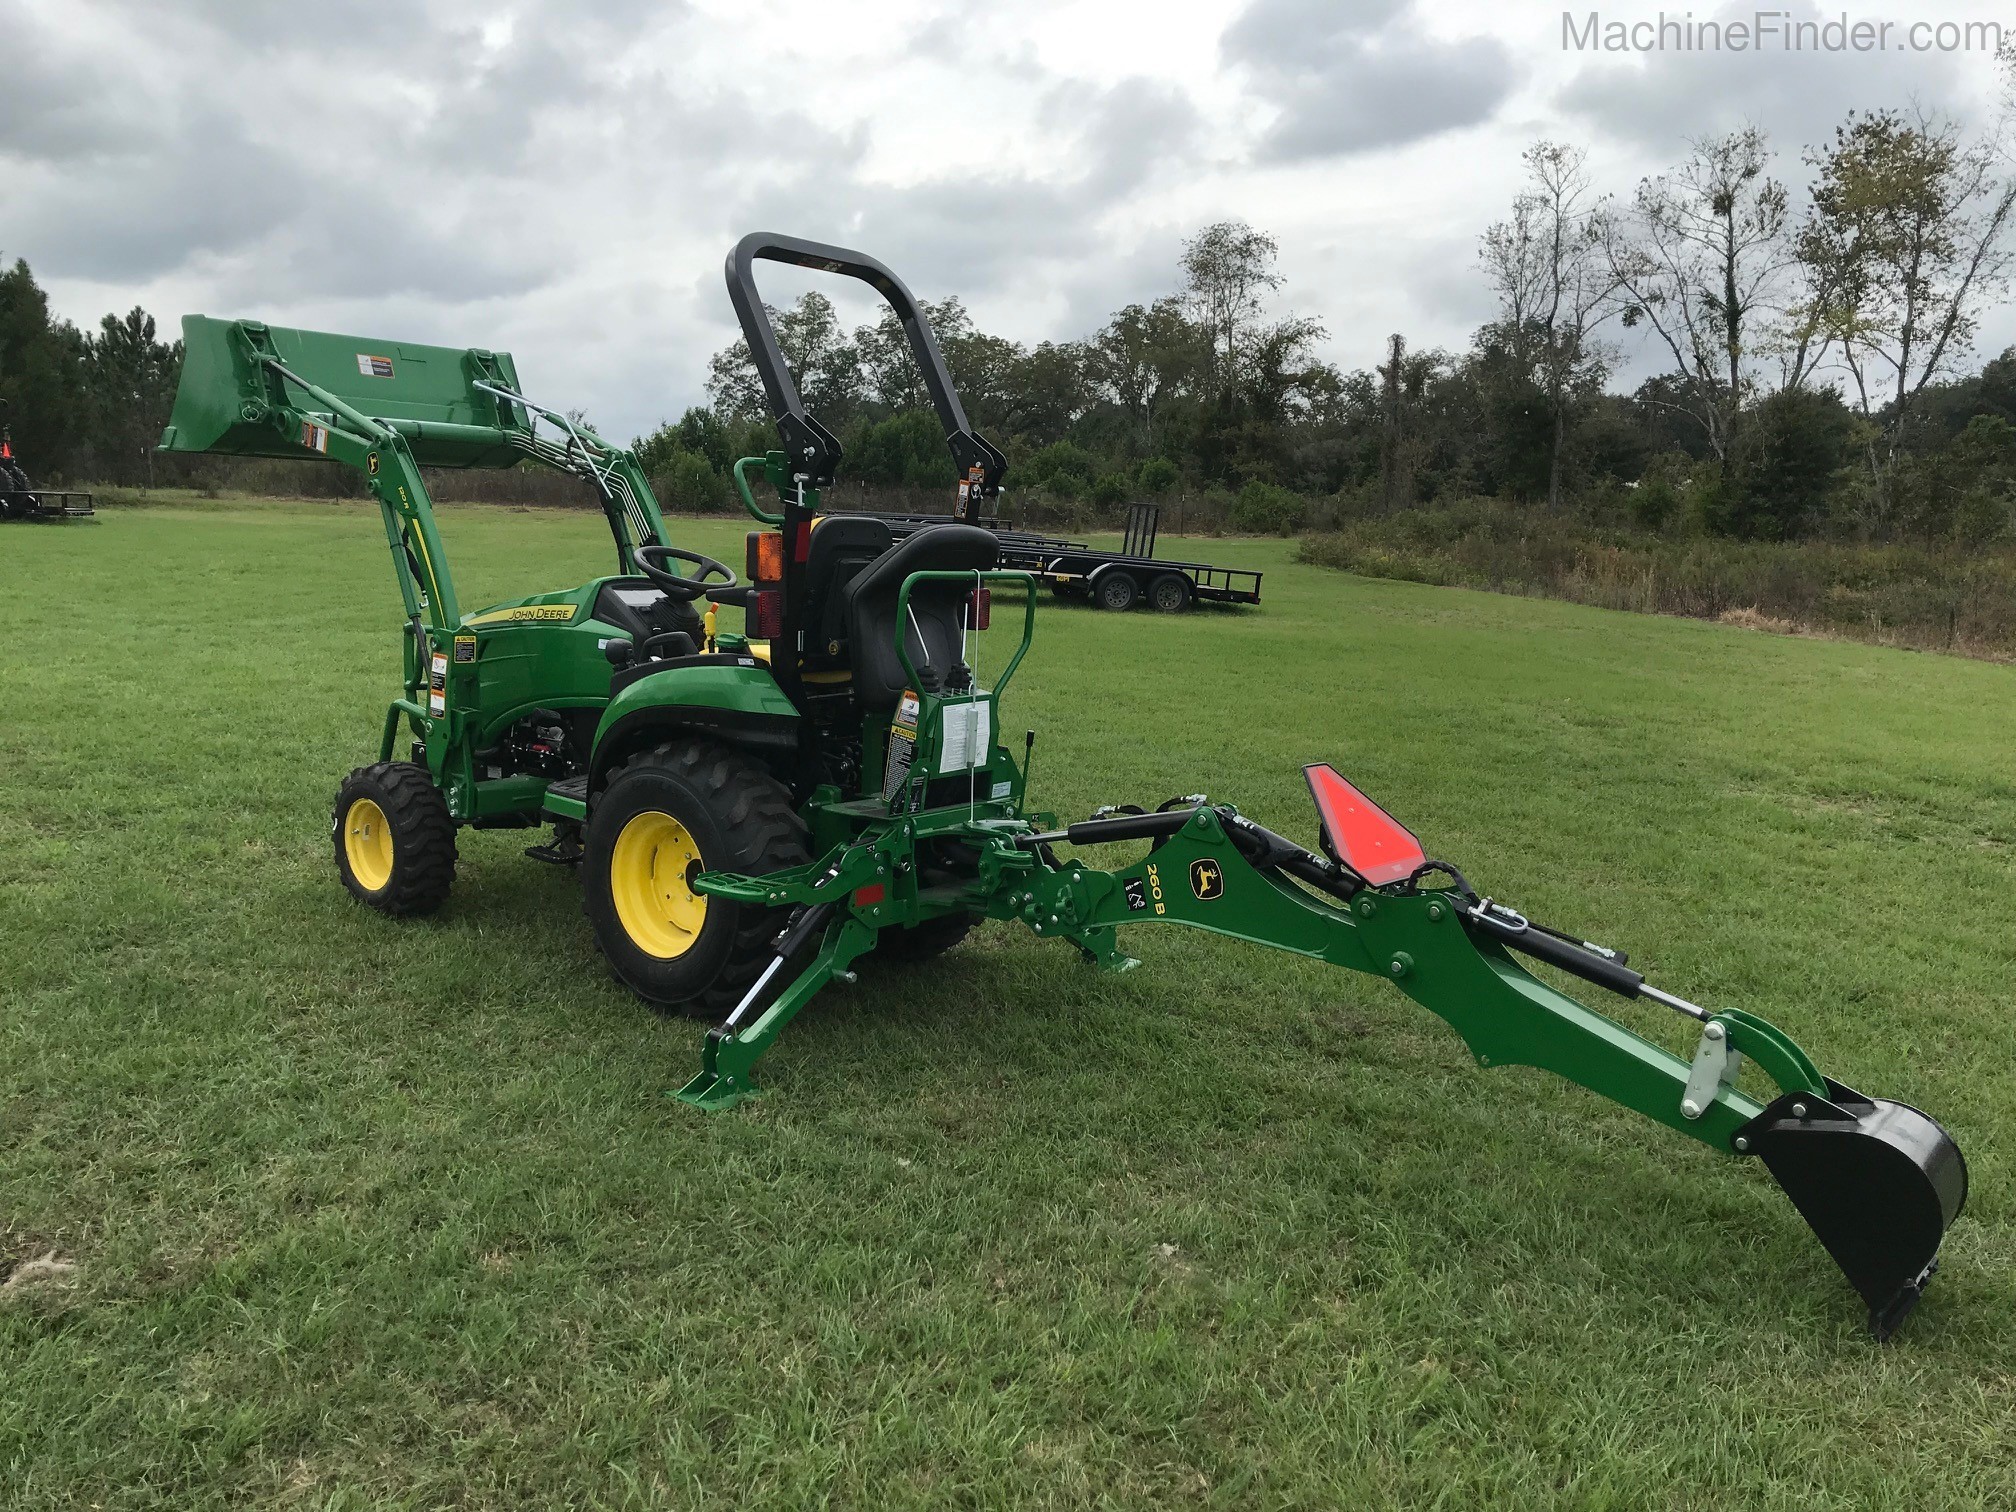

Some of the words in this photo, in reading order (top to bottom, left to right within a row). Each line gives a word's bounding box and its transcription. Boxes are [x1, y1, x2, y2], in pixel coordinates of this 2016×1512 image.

[509, 609, 535, 620] JOHN
[536, 608, 570, 619] DEERE
[898, 727, 917, 739] CAUTION
[1146, 863, 1162, 900] 260
[1154, 902, 1166, 915] B
